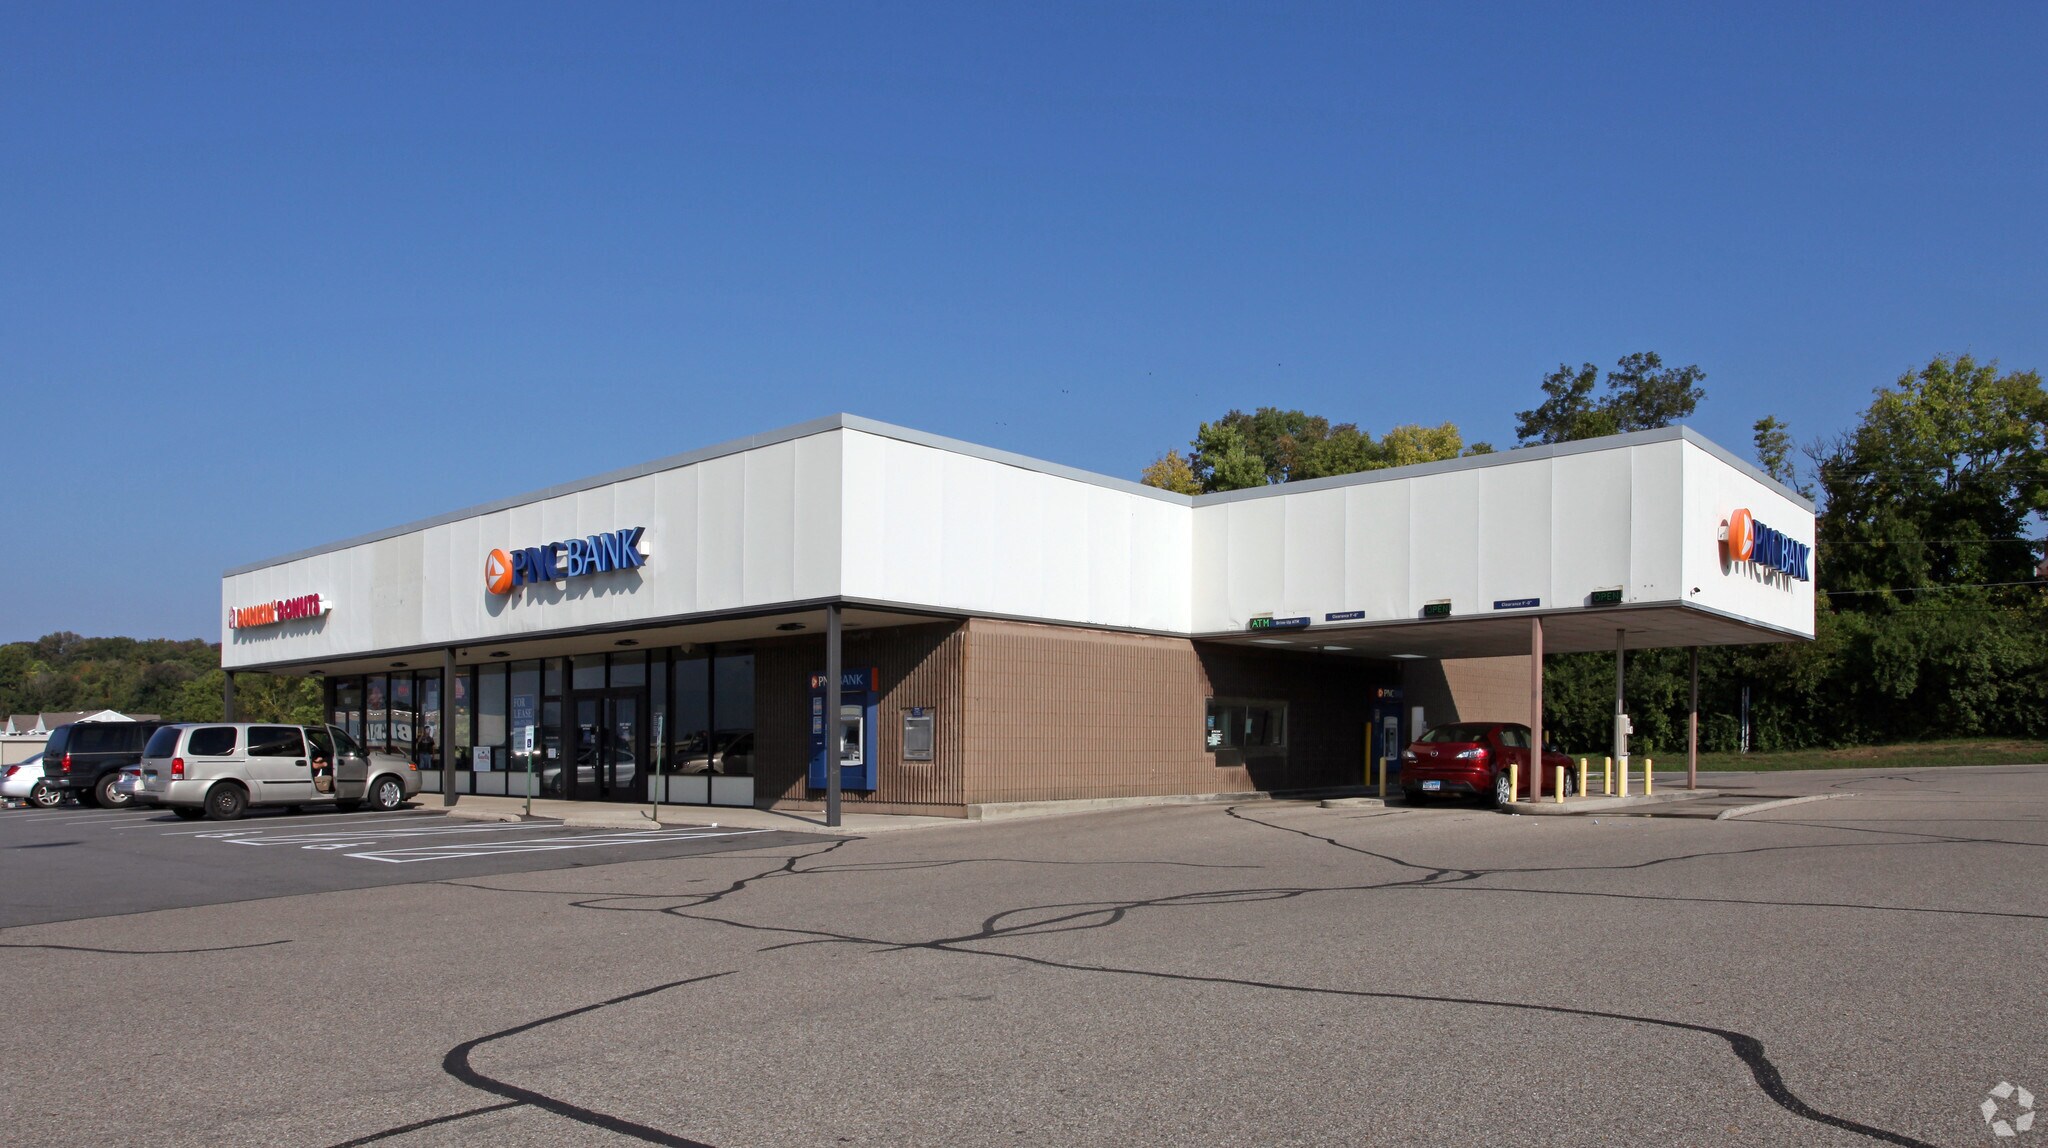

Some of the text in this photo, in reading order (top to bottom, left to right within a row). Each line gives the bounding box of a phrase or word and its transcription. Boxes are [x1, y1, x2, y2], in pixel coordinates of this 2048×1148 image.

[510, 526, 646, 586] PNC BANK
[1752, 519, 1811, 582] PNC BANK
[1593, 591, 1621, 602] OPEN
[236, 592, 321, 629] DUNKIN' DONUTS
[1426, 604, 1450, 615] OPEN
[1252, 619, 1270, 628] ATM
[513, 697, 526, 708] FOR
[513, 708, 533, 718] LEASE
